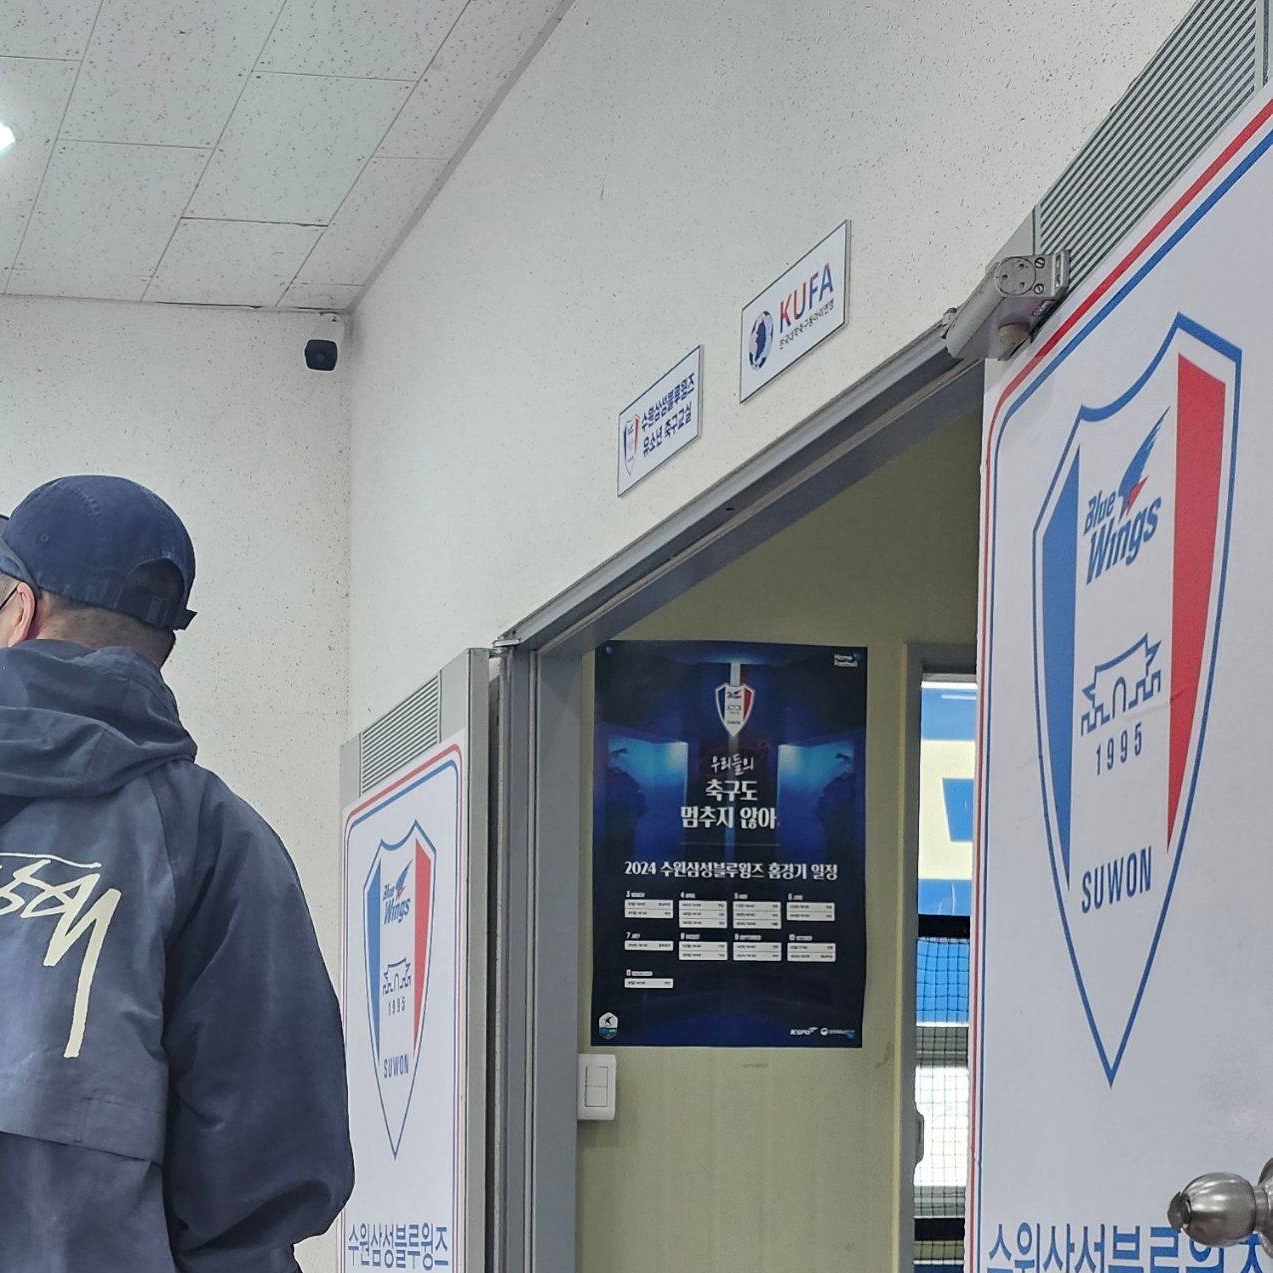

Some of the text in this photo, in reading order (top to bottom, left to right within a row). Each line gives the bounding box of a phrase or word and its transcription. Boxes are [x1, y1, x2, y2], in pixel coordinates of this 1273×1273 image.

[780, 262, 834, 334] KUFA
[641, 372, 695, 432] 수원삼성블루윙즈
[643, 401, 692, 458] 유소년 축구교실
[1083, 490, 1116, 537] Blue
[1085, 497, 1161, 585] Wings
[711, 754, 754, 776] 우리들의
[1095, 737, 1143, 776] 1995
[705, 779, 758, 802] 축구도
[680, 806, 777, 830] 멈추지 않아
[624, 861, 838, 881] 2024 수원삼성블루윙즈 홈경기 일정
[1081, 845, 1152, 913] SUWON
[388, 997, 406, 1016] 1995
[383, 1053, 409, 1079] SUWON
[348, 1222, 449, 1271] 수원삼성블루윙즈
